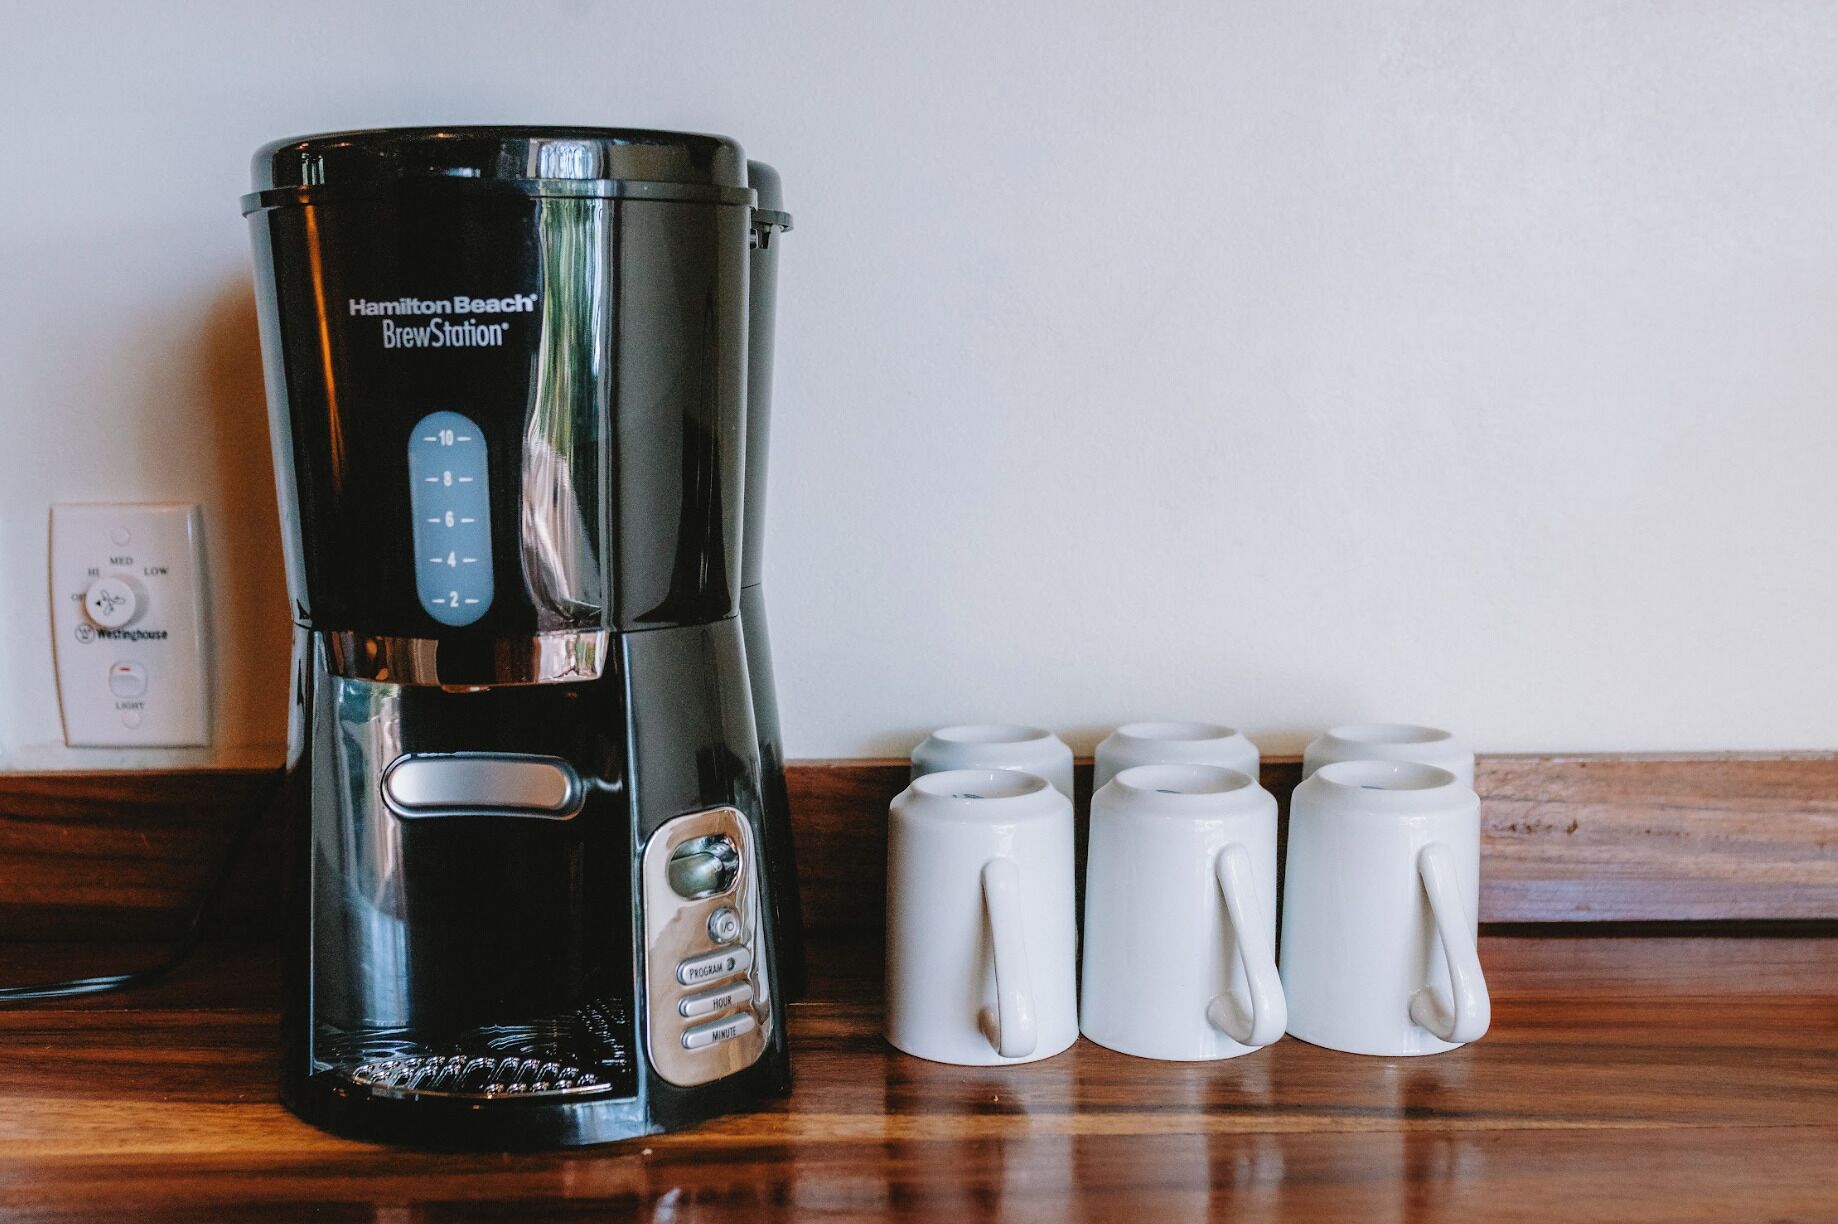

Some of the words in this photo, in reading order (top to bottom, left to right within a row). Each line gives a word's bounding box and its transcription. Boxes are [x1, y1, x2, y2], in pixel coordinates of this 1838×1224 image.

[350, 298, 451, 316] Hamilton
[453, 293, 534, 314] Beach
[382, 317, 503, 349] BrewStation
[438, 429, 454, 446] 10
[443, 470, 453, 487] 8
[445, 511, 455, 528] 6
[109, 556, 134, 566] MED
[447, 551, 457, 568] 4
[143, 567, 169, 576] LOW
[449, 591, 459, 608] 2
[115, 701, 145, 711] LIGHT
[689, 962, 724, 980] PROGRAM
[712, 995, 732, 1010] HOUR
[712, 1026, 737, 1041] MINUTE
